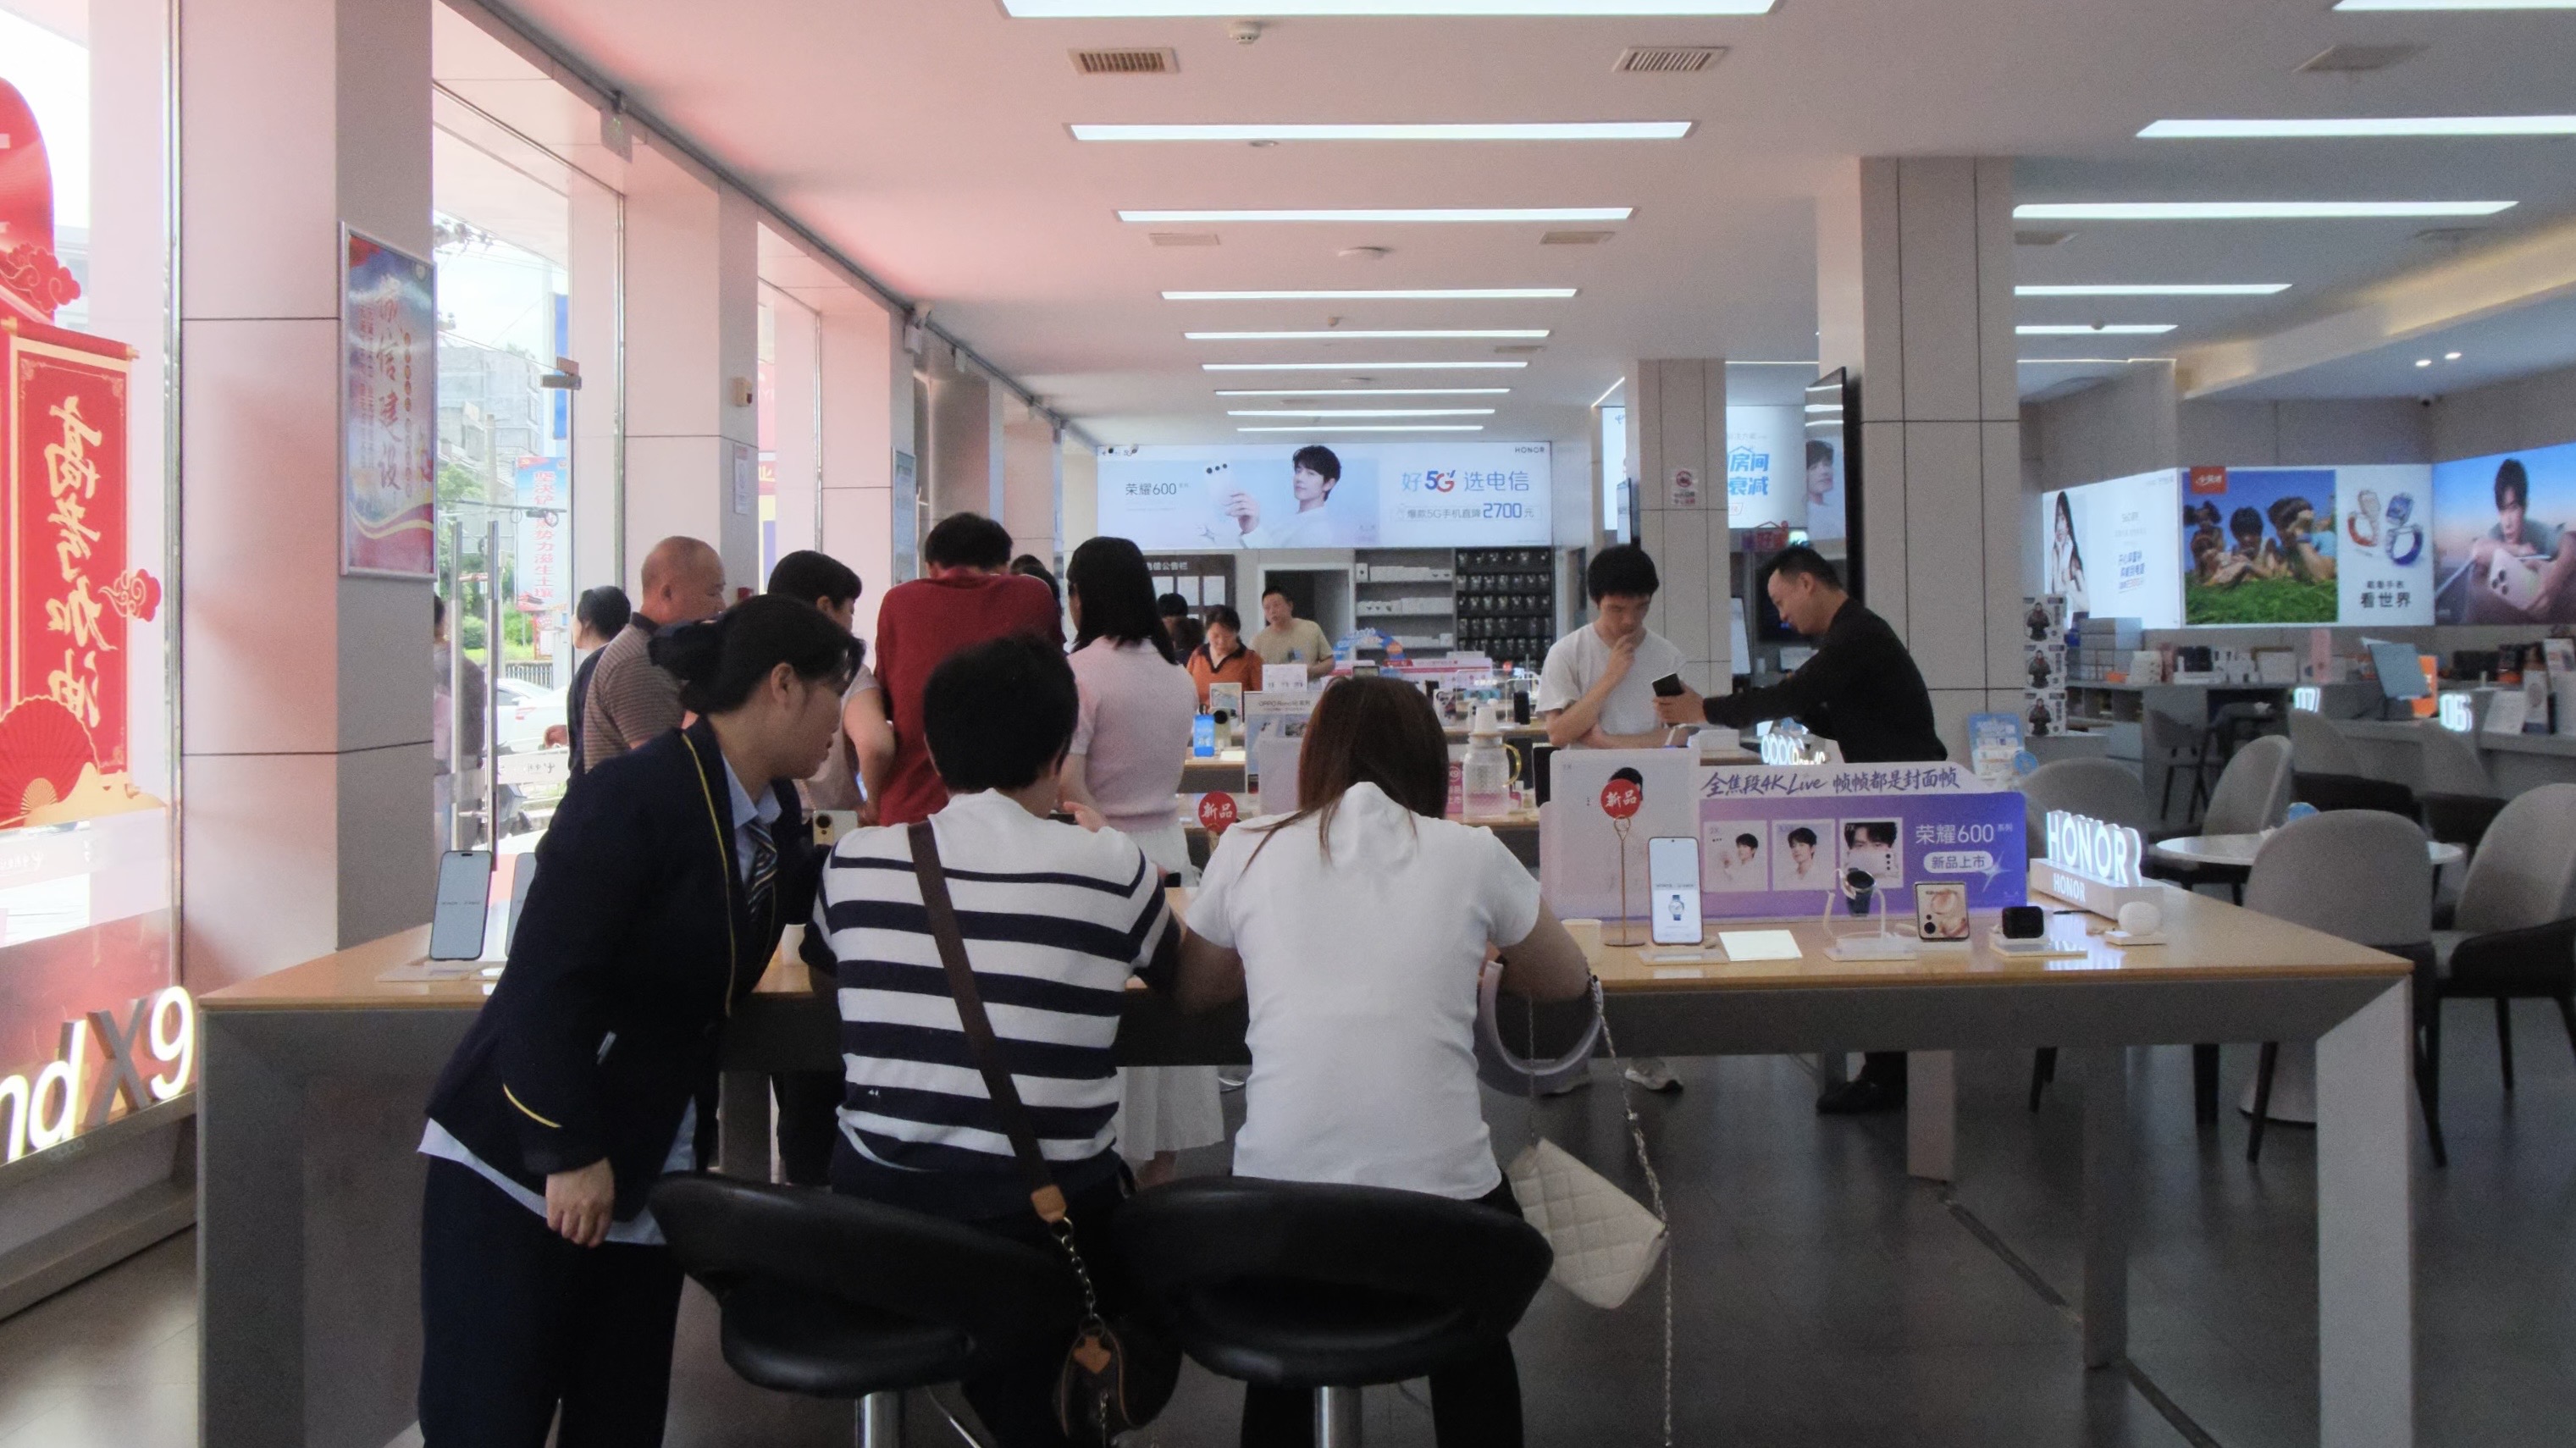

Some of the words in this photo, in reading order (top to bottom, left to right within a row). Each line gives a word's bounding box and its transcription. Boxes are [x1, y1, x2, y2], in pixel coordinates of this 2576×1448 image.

[1727, 453, 1770, 473] 房间
[1125, 483, 1177, 497] 荣耀600
[1463, 471, 1530, 493] 选电信
[1728, 477, 1769, 496] 衰减
[533, 470, 556, 598] 坚决铲势力滋生土壤
[2360, 592, 2411, 609] 看世界
[2440, 693, 2473, 732] 06
[1786, 772, 1827, 797] Live
[1832, 766, 1961, 794] 帧帧都是封面帧
[1605, 788, 1638, 809] 新品
[1201, 801, 1233, 820] 新品
[1915, 824, 1994, 845] 荣耀600
[2046, 810, 2131, 887] HONOR
[1931, 854, 1986, 870] 新品上市
[2053, 872, 2087, 903] HONOR
[86, 985, 196, 1127] X9
